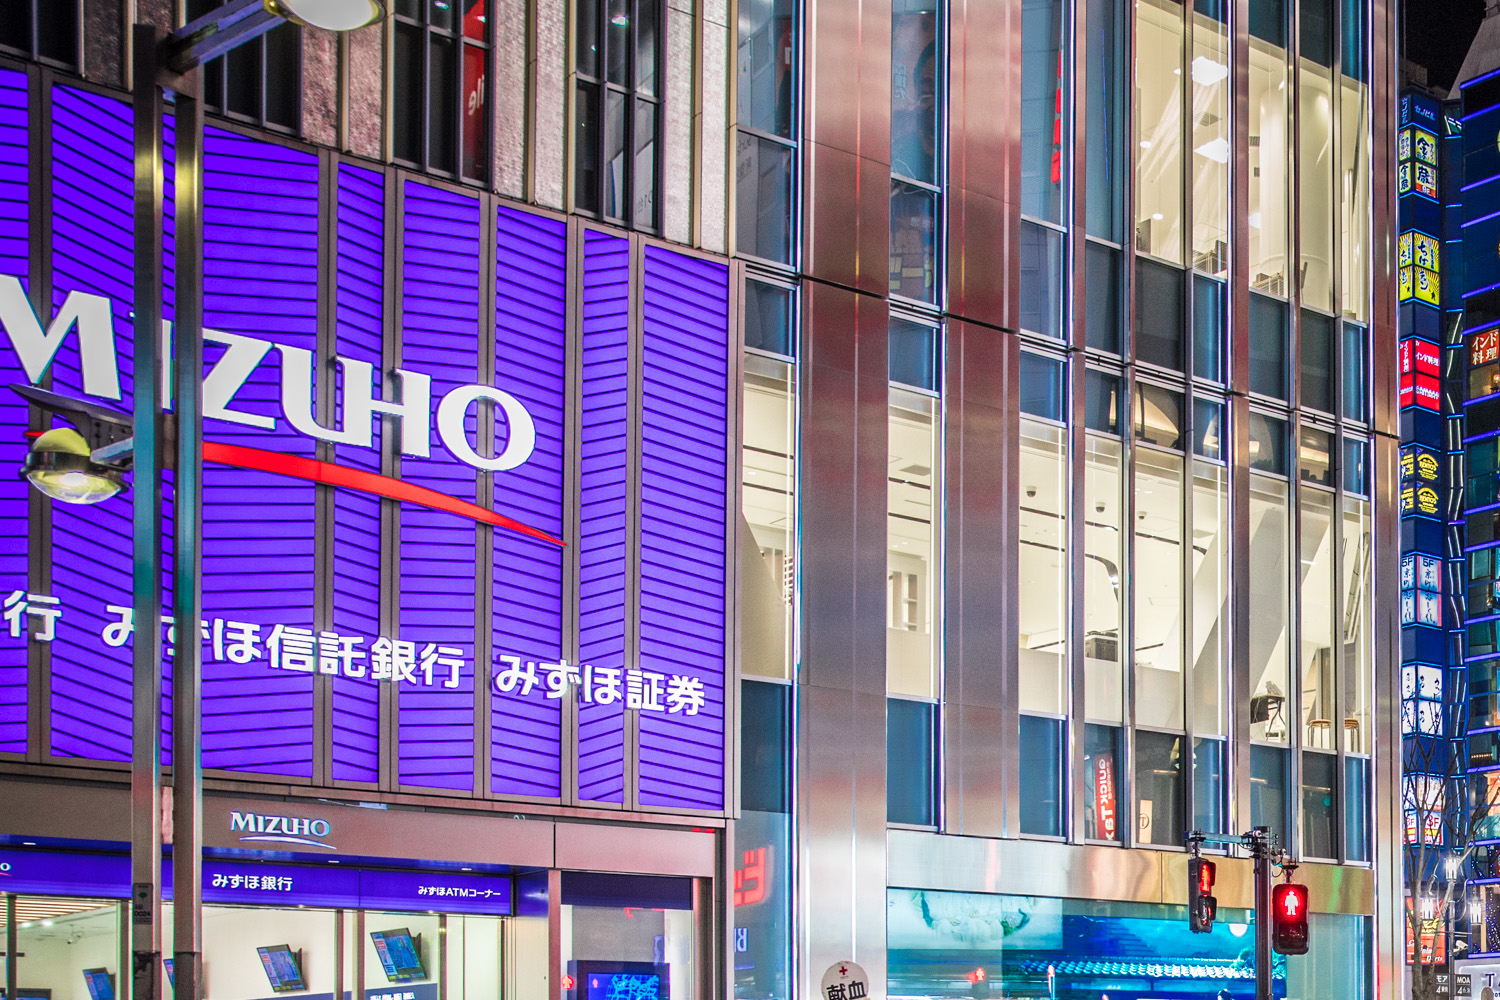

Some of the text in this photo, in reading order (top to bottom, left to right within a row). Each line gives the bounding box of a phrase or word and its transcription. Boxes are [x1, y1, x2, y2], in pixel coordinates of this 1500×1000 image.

[1472, 332, 1498, 351] インド
[1472, 346, 1498, 365] 料理
[1402, 557, 1413, 567] 5F
[1422, 557, 1435, 567] 5F
[494, 653, 706, 717] みずほ証券
[230, 811, 331, 837] MIZUHO
[1426, 815, 1439, 828] 3F
[211, 873, 294, 892] みずほ銀行
[418, 885, 502, 898] みずほATMコーナー
